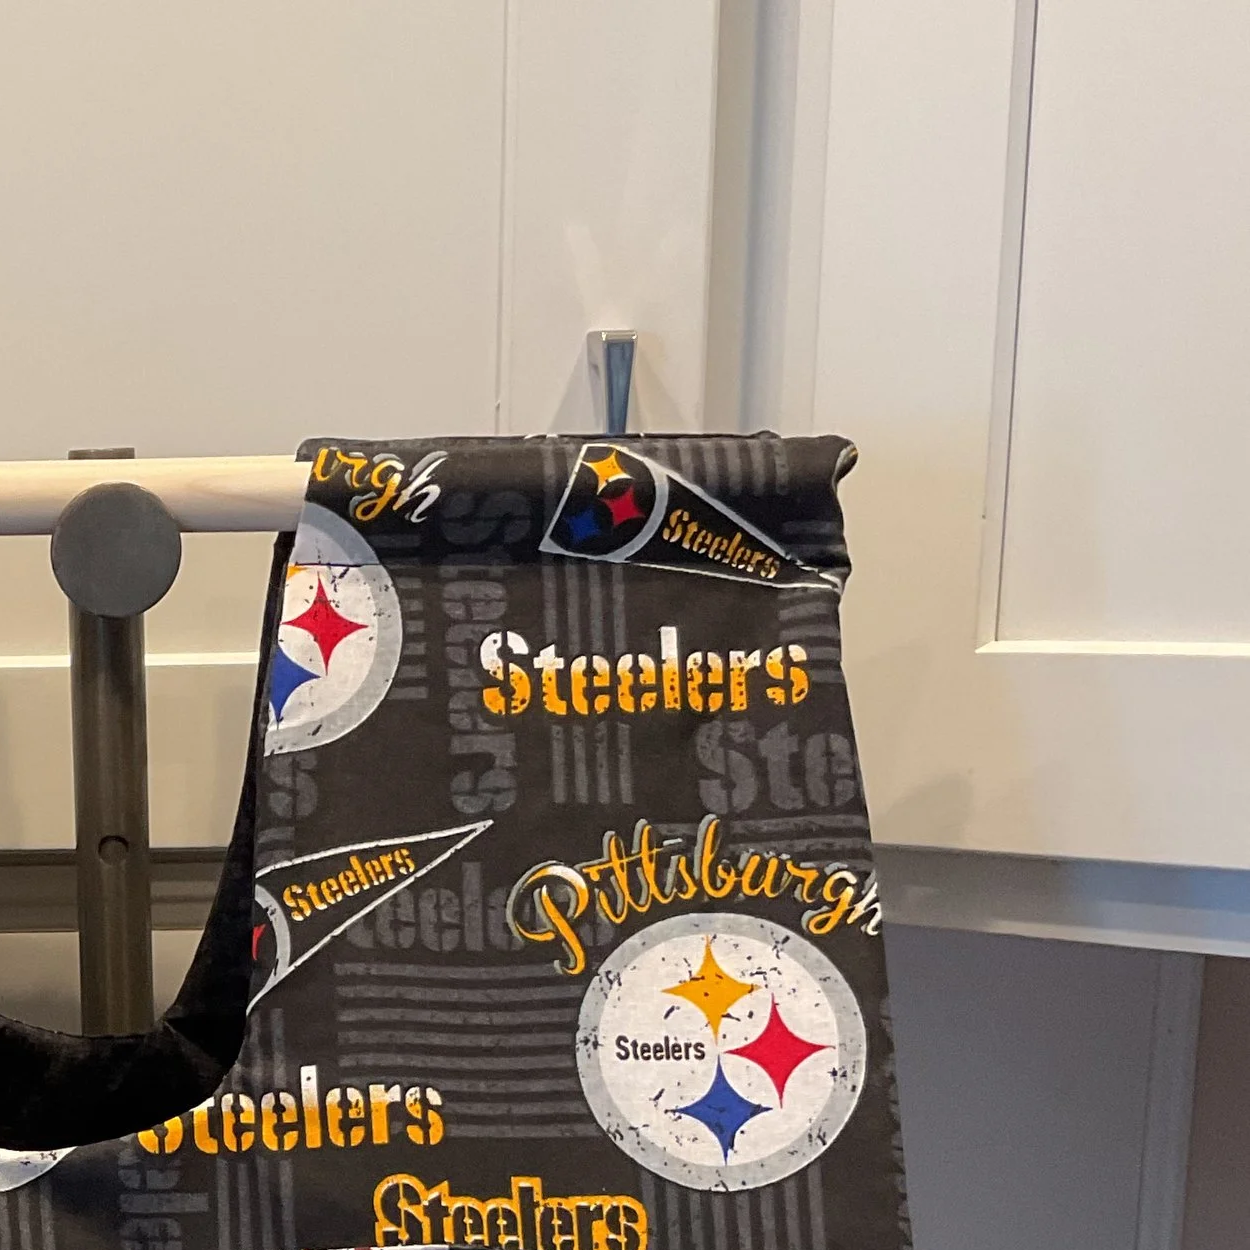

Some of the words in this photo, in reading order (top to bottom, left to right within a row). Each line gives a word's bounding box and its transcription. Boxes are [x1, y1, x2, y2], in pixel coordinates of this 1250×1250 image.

[662, 508, 781, 579] Steelers
[478, 624, 809, 717] Steelers
[283, 847, 416, 922] Steelers
[507, 813, 882, 976] Pittsburgh
[616, 1035, 706, 1062] Steelers
